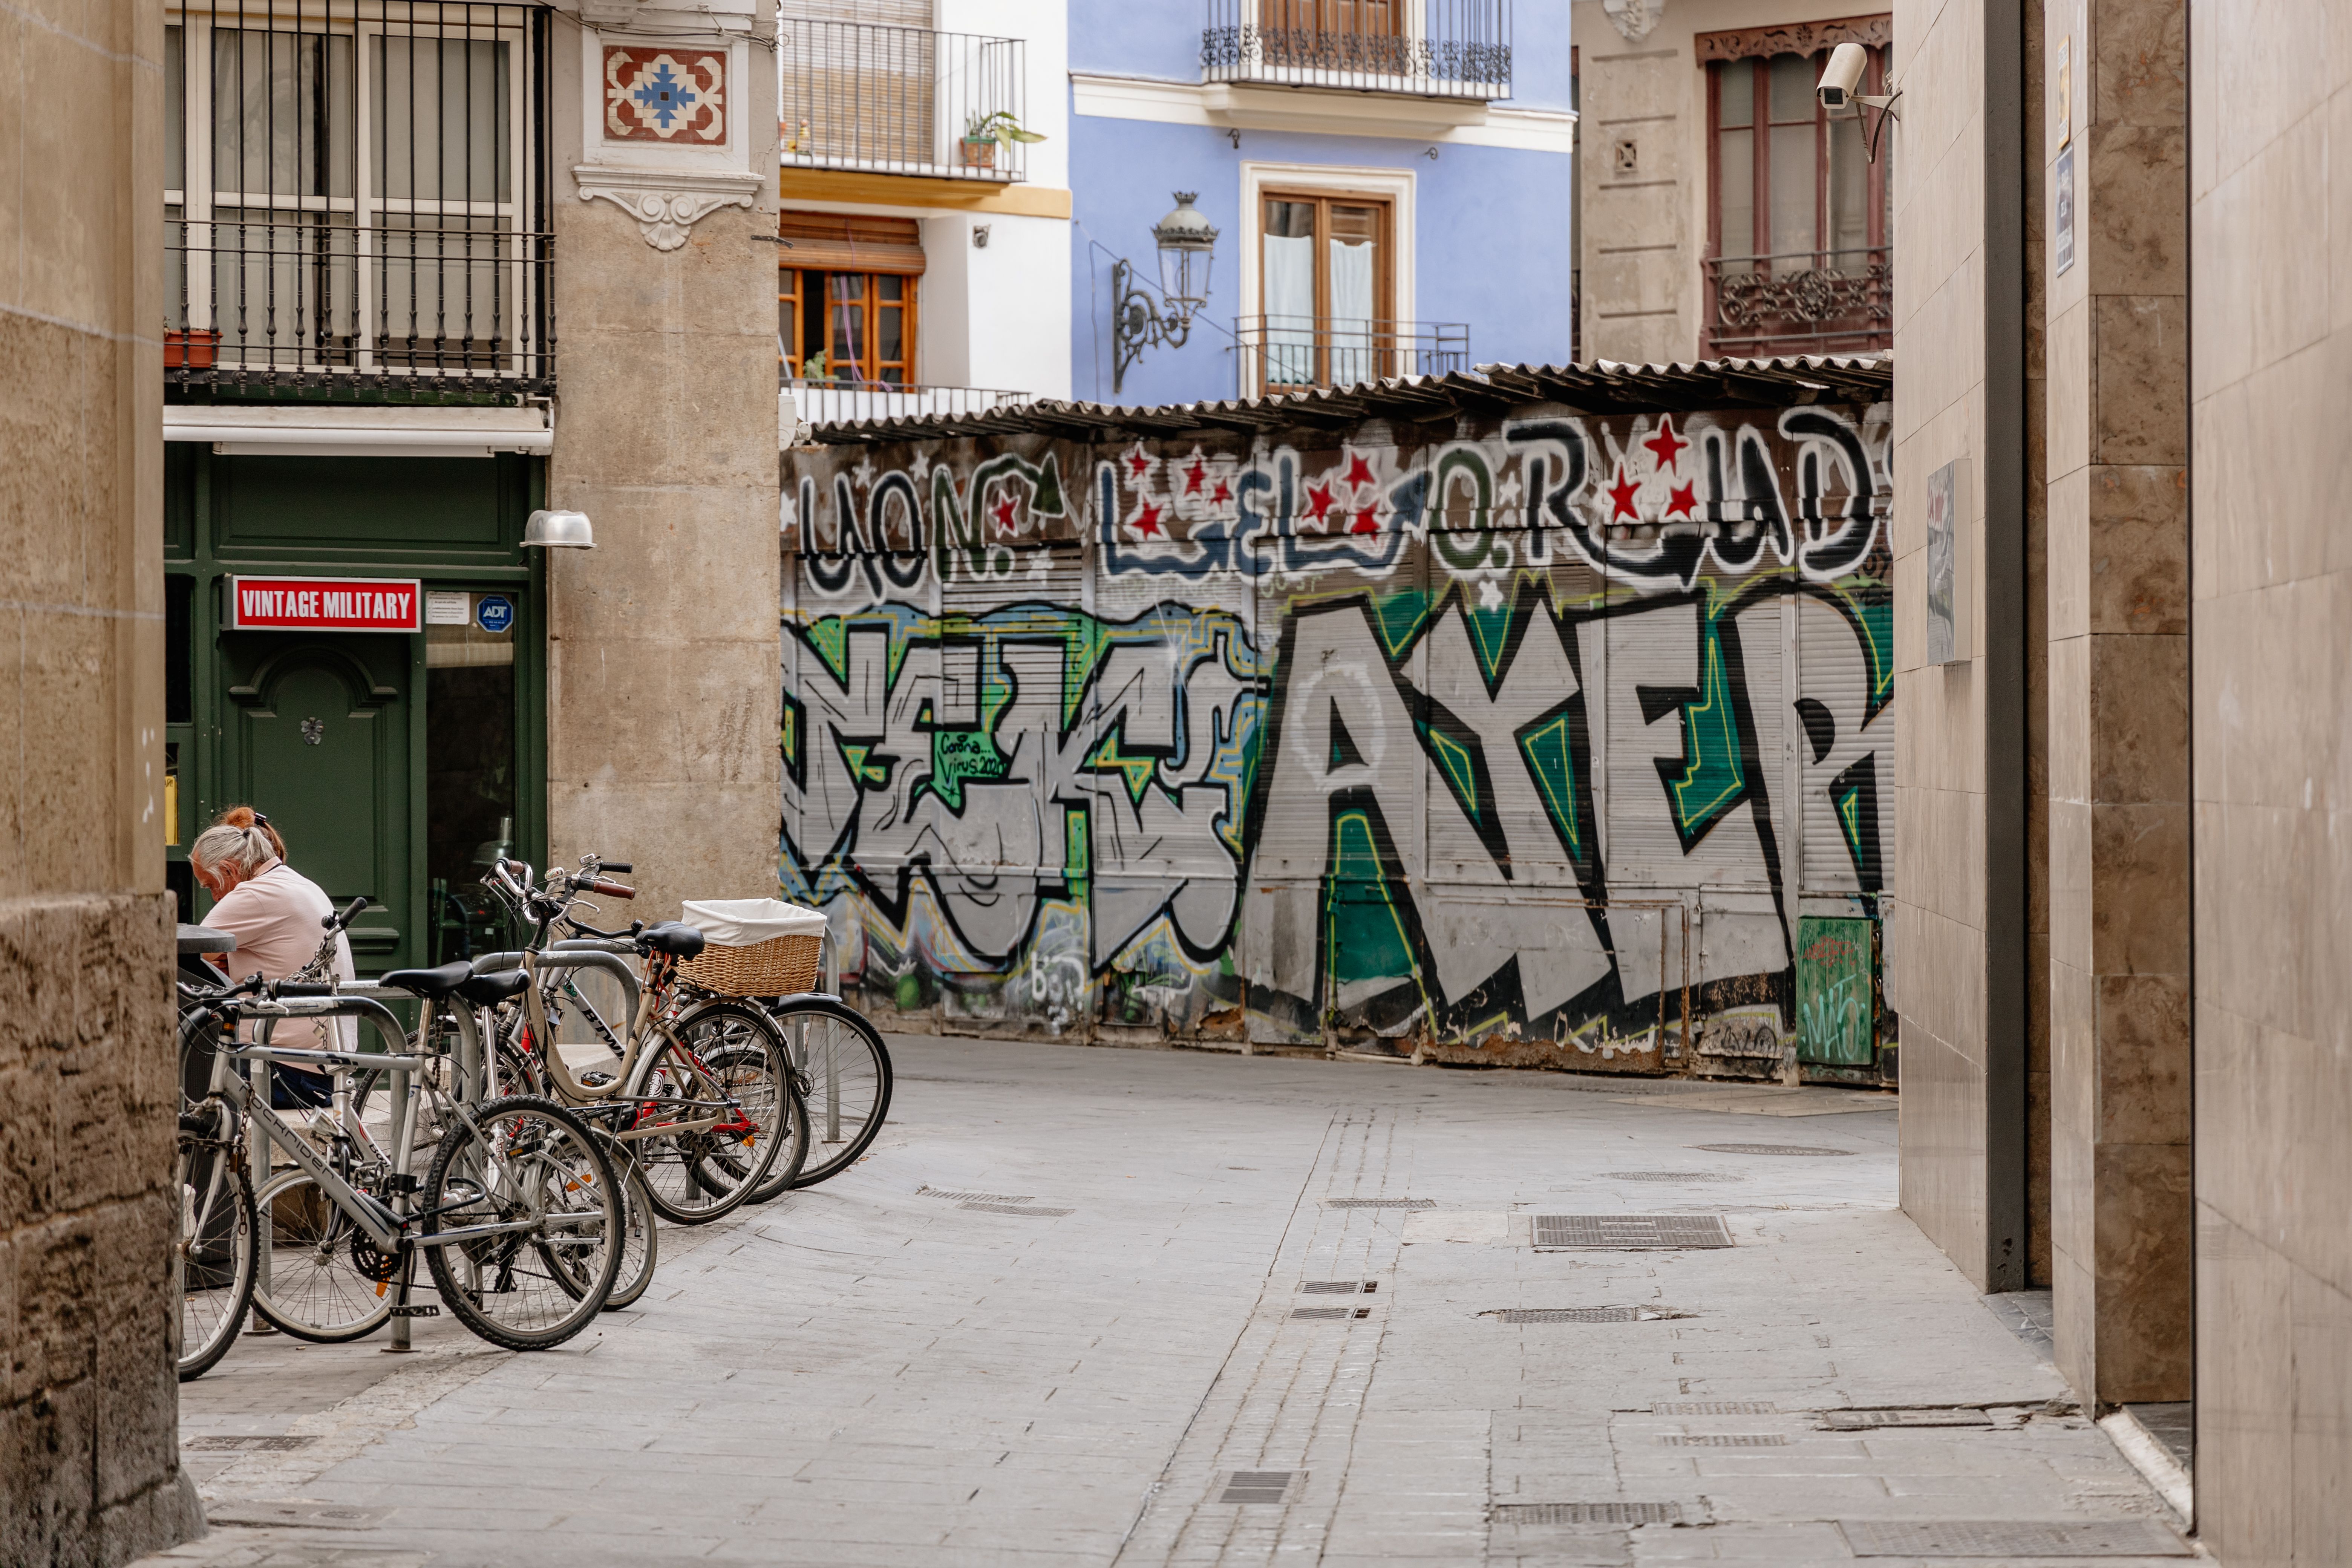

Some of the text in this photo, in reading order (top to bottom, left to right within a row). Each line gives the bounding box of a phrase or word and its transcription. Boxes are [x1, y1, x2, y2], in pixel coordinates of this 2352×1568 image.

[242, 590, 319, 617] VINTAGE
[323, 592, 410, 619] MILITARY
[483, 606, 507, 618] ADT
